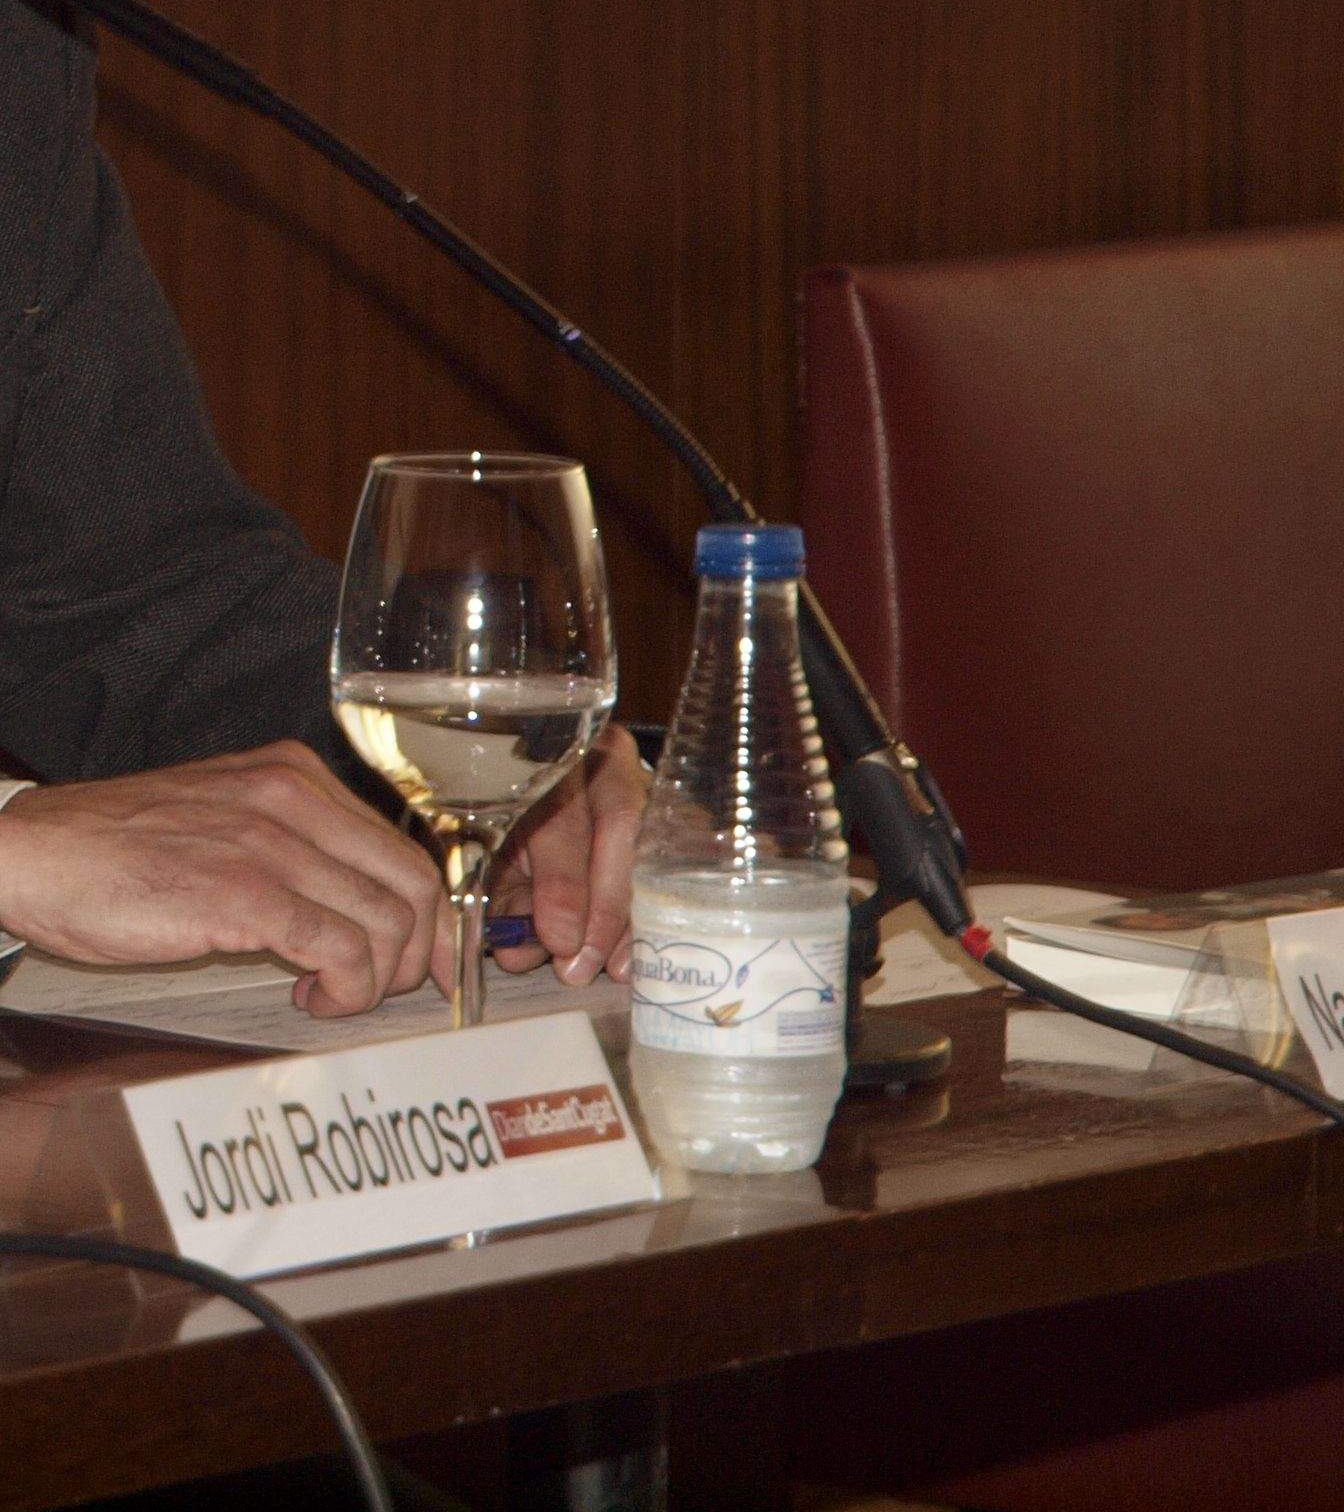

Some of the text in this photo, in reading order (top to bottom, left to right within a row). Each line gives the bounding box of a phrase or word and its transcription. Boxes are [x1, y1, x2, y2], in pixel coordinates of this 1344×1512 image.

[632, 957, 715, 987] quaBona
[175, 1088, 498, 1219] Jordi Robirosa
